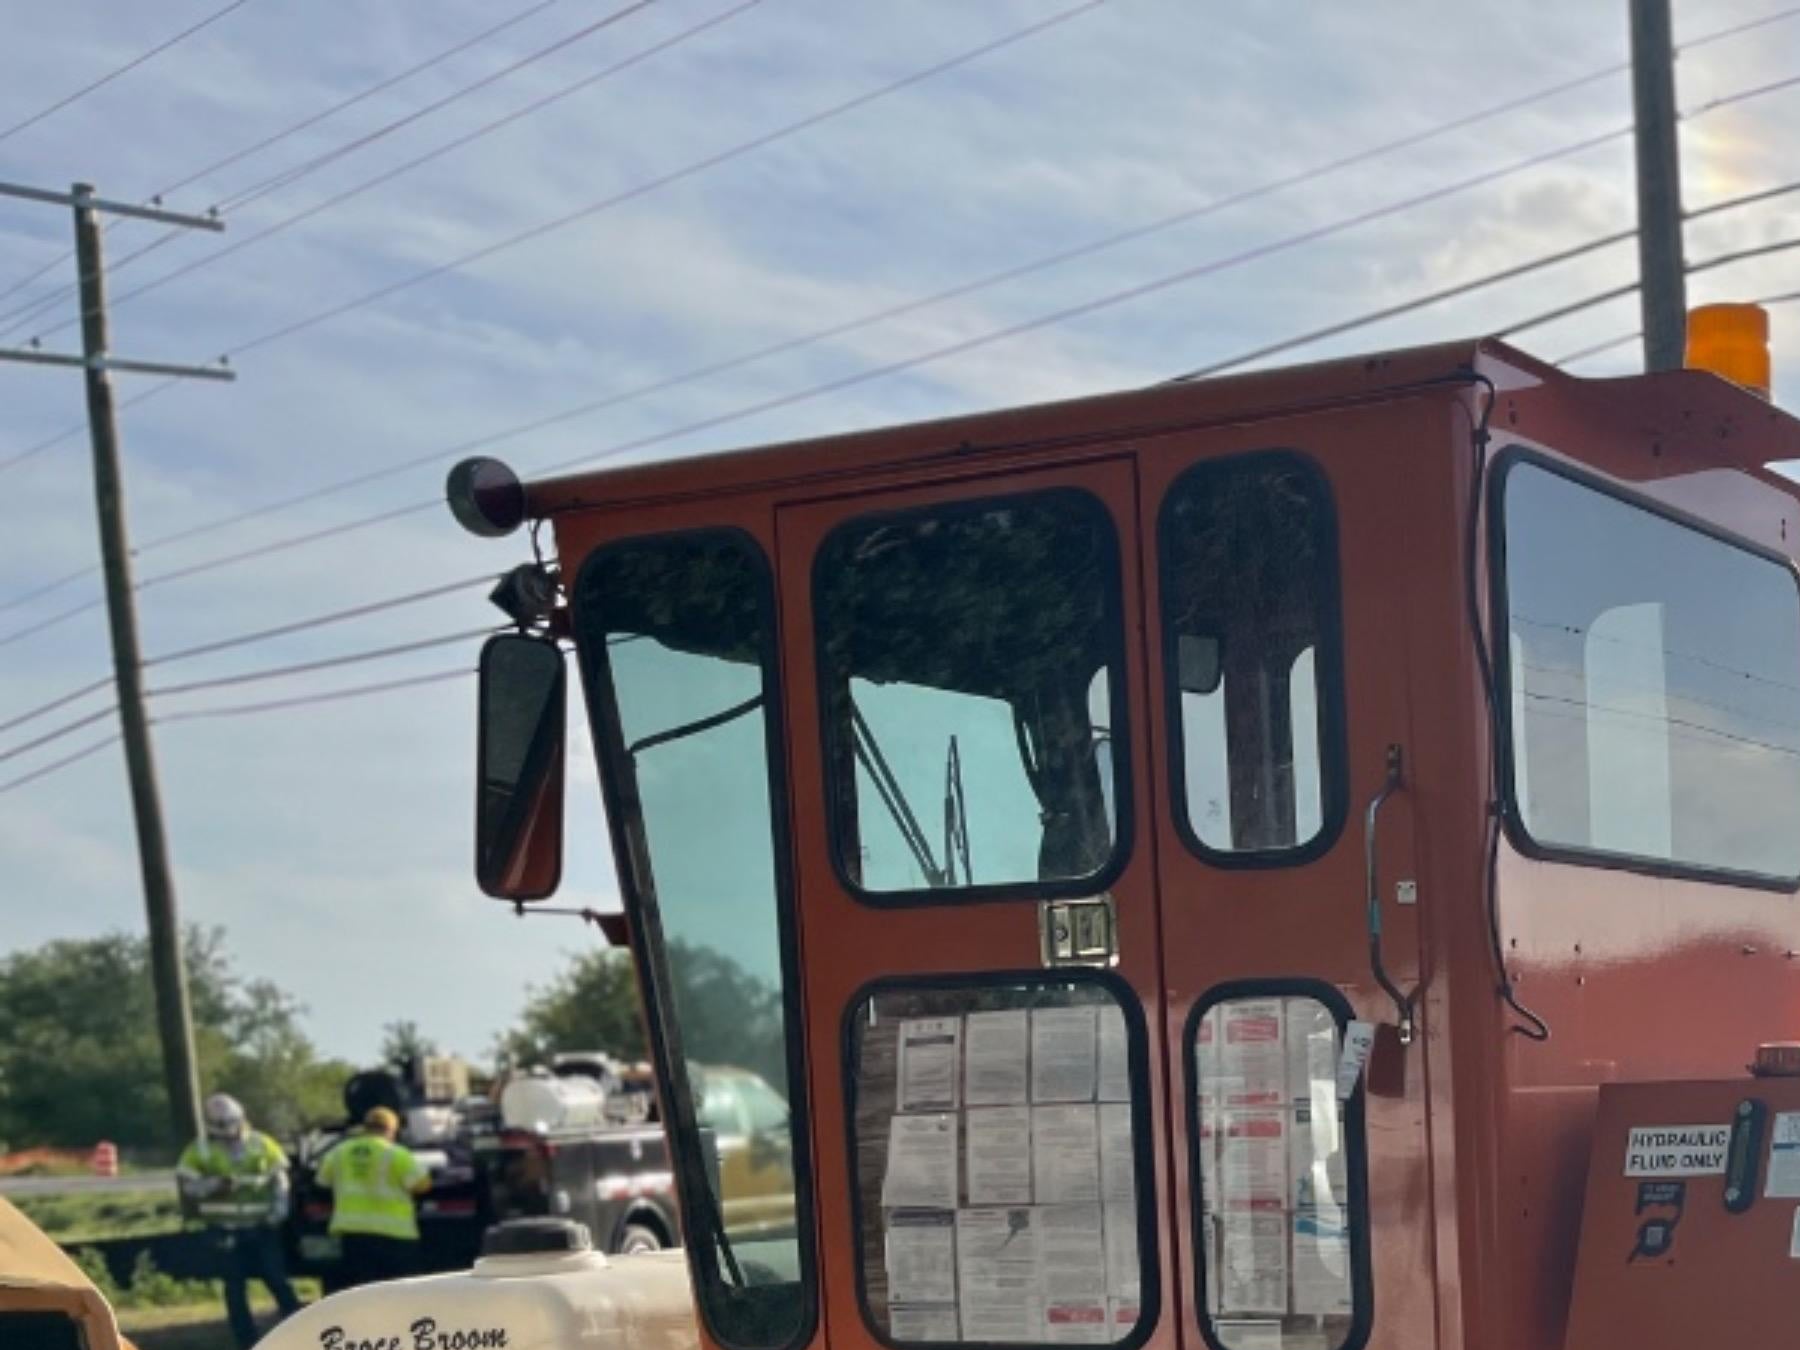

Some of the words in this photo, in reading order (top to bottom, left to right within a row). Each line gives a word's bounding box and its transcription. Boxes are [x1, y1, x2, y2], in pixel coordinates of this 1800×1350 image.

[1631, 1130, 1728, 1149] HYDRAULIC
[1629, 1154, 1678, 1171] FLUID
[1680, 1152, 1723, 1169] ONLY
